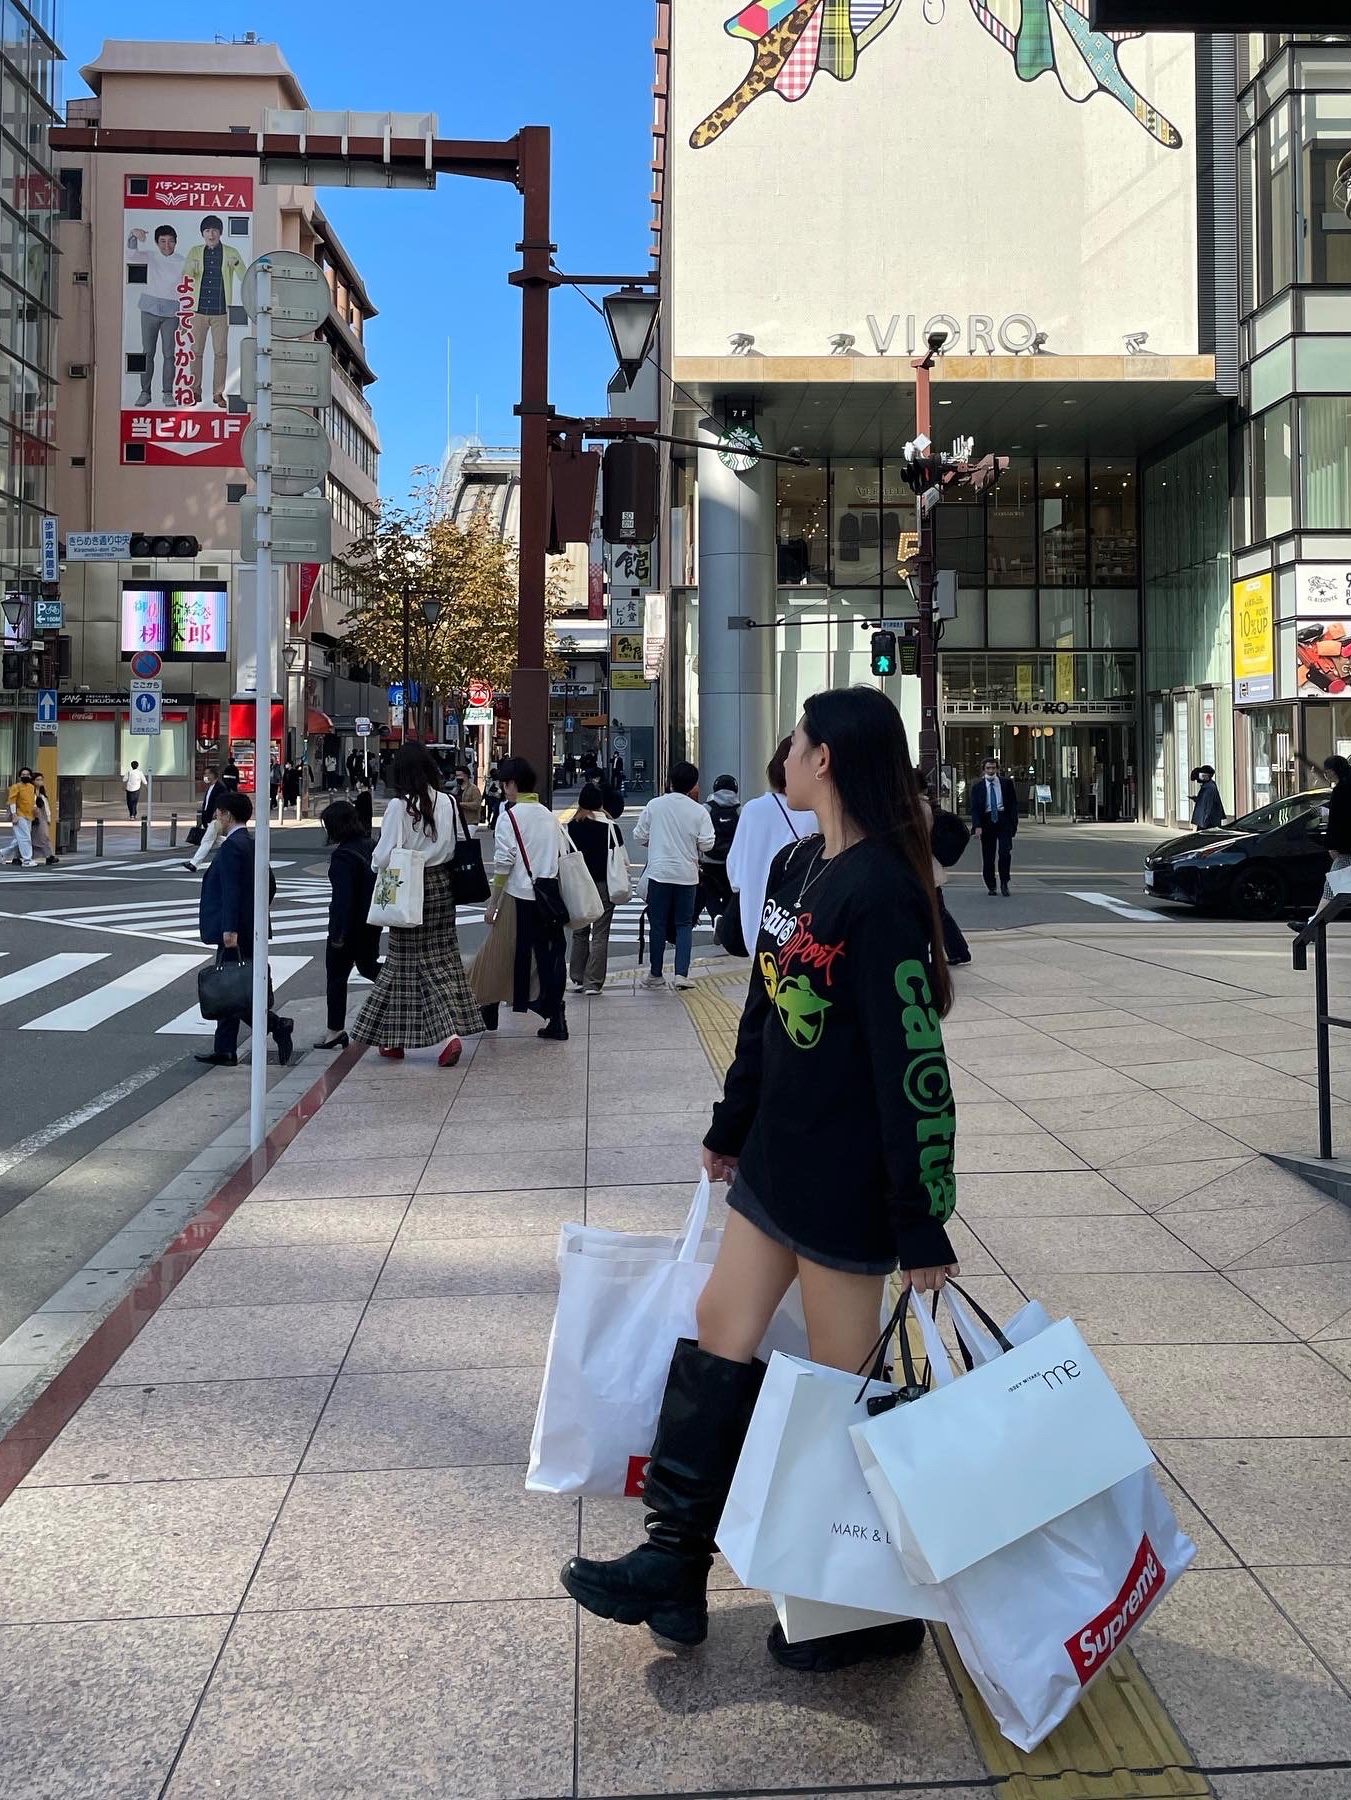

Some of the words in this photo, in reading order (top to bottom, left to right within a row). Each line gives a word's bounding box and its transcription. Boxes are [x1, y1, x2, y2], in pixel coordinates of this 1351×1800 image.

[154, 181, 225, 192] パチンコ・スロット
[189, 192, 247, 208] PLAZA
[175, 275, 197, 406] よっていかんね
[866, 313, 1038, 353] VIORO
[131, 417, 201, 439] 当ビル
[211, 419, 241, 439] 1F
[68, 535, 130, 547] きらめき通り中央
[614, 549, 650, 580] 館
[616, 606, 626, 626] ビル
[627, 600, 637, 622] 食堂
[133, 681, 160, 689] ここから
[1041, 1359, 1081, 1390] me
[831, 1522, 868, 1540] MARK
[872, 1529, 882, 1543] &
[1079, 1552, 1158, 1668] Supreme
